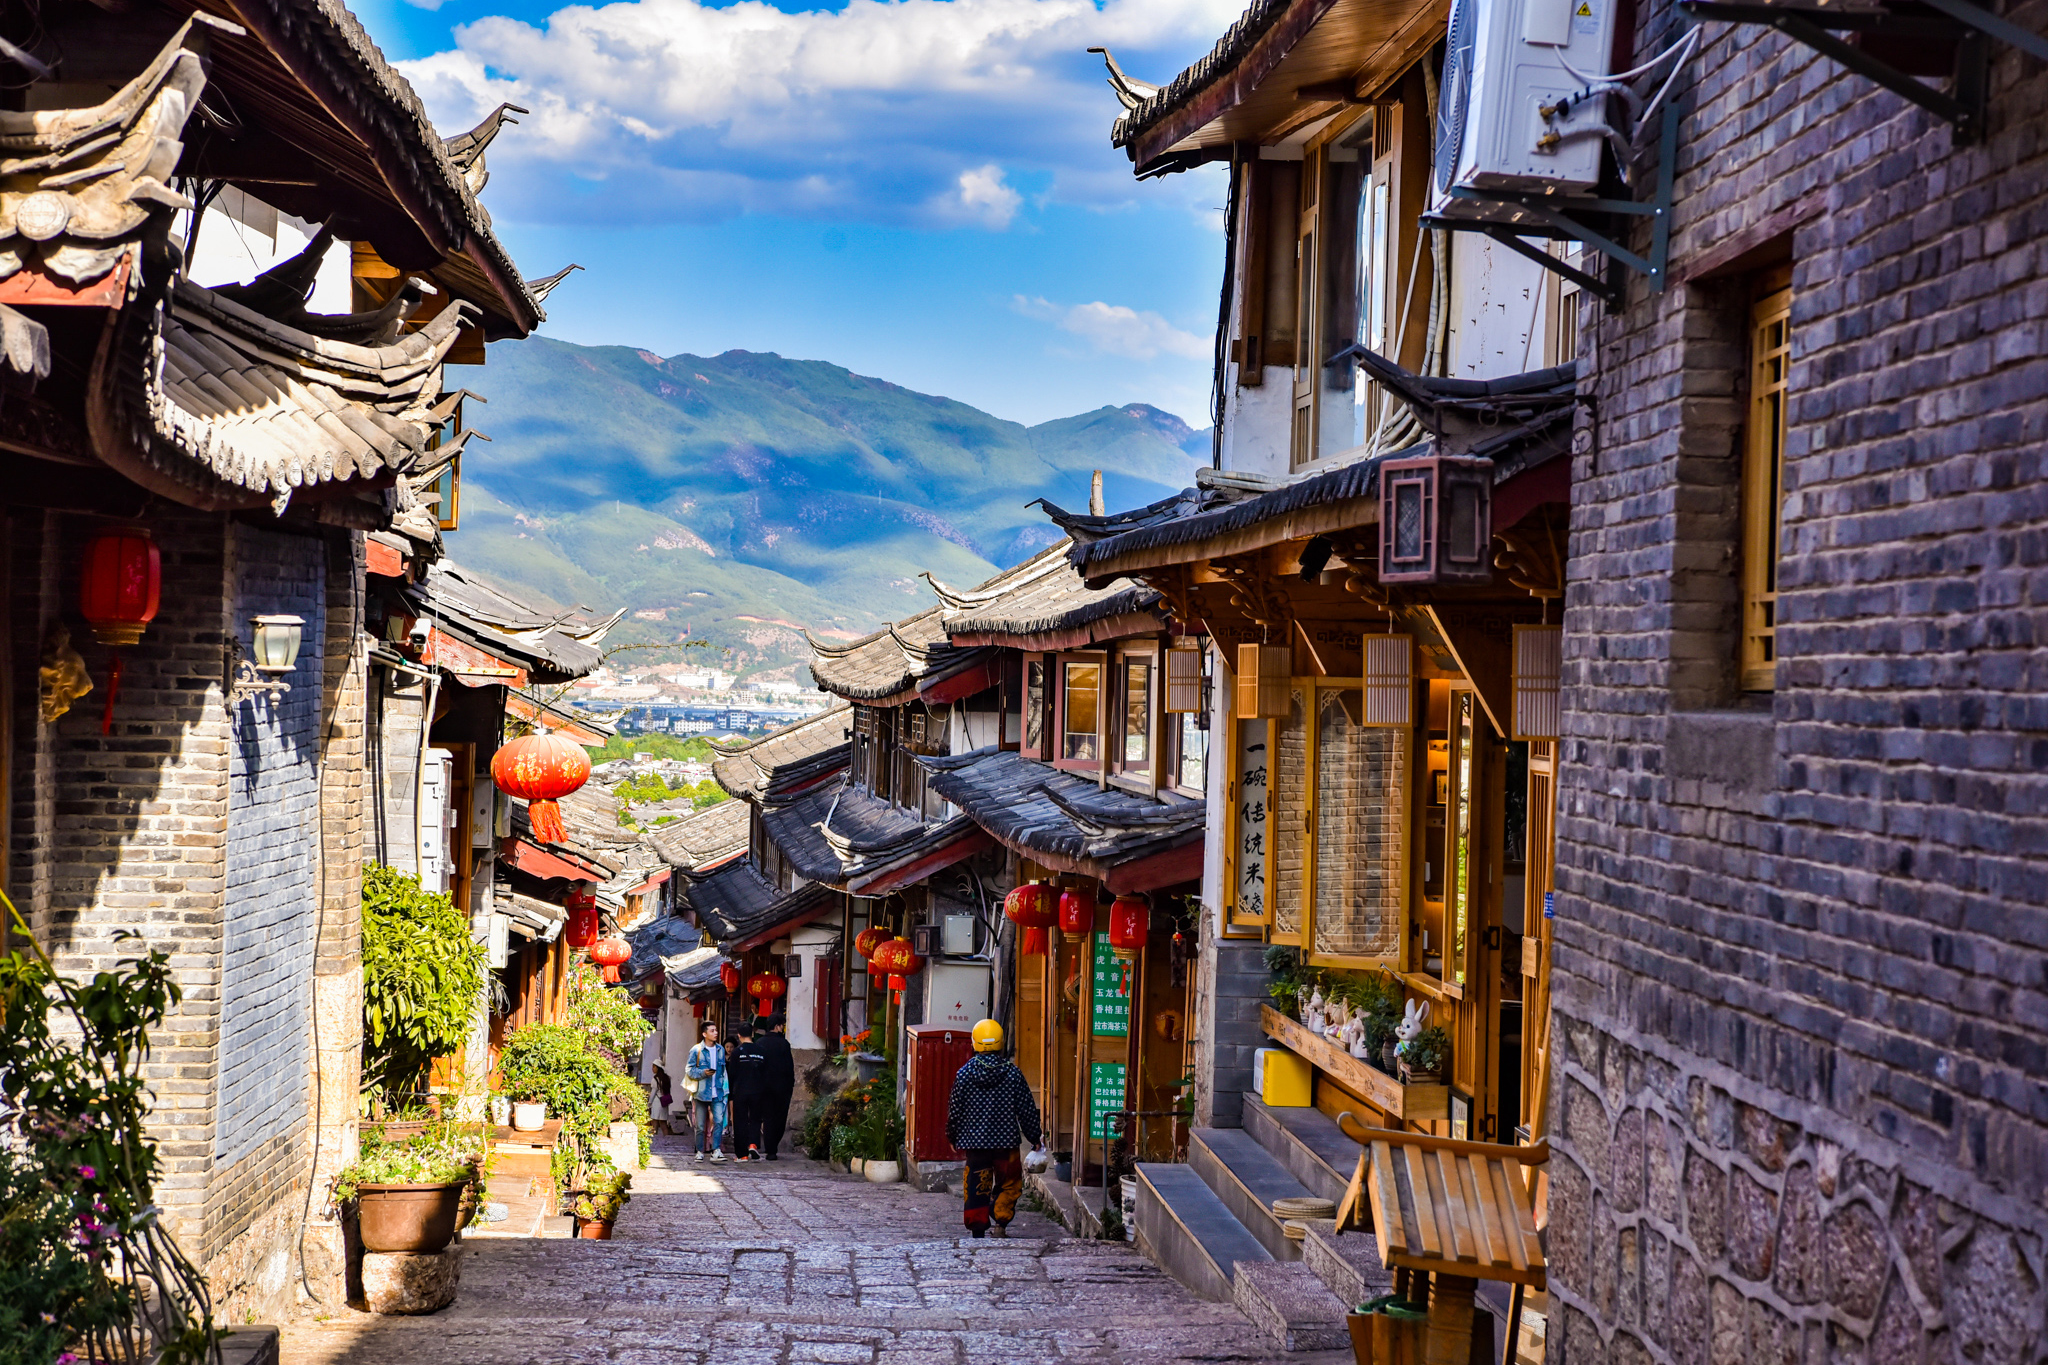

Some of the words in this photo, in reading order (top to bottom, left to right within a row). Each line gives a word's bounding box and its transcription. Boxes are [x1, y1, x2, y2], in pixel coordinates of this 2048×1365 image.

[513, 752, 542, 782] 福
[1094, 1021, 1128, 1031] 拉市海茶马
